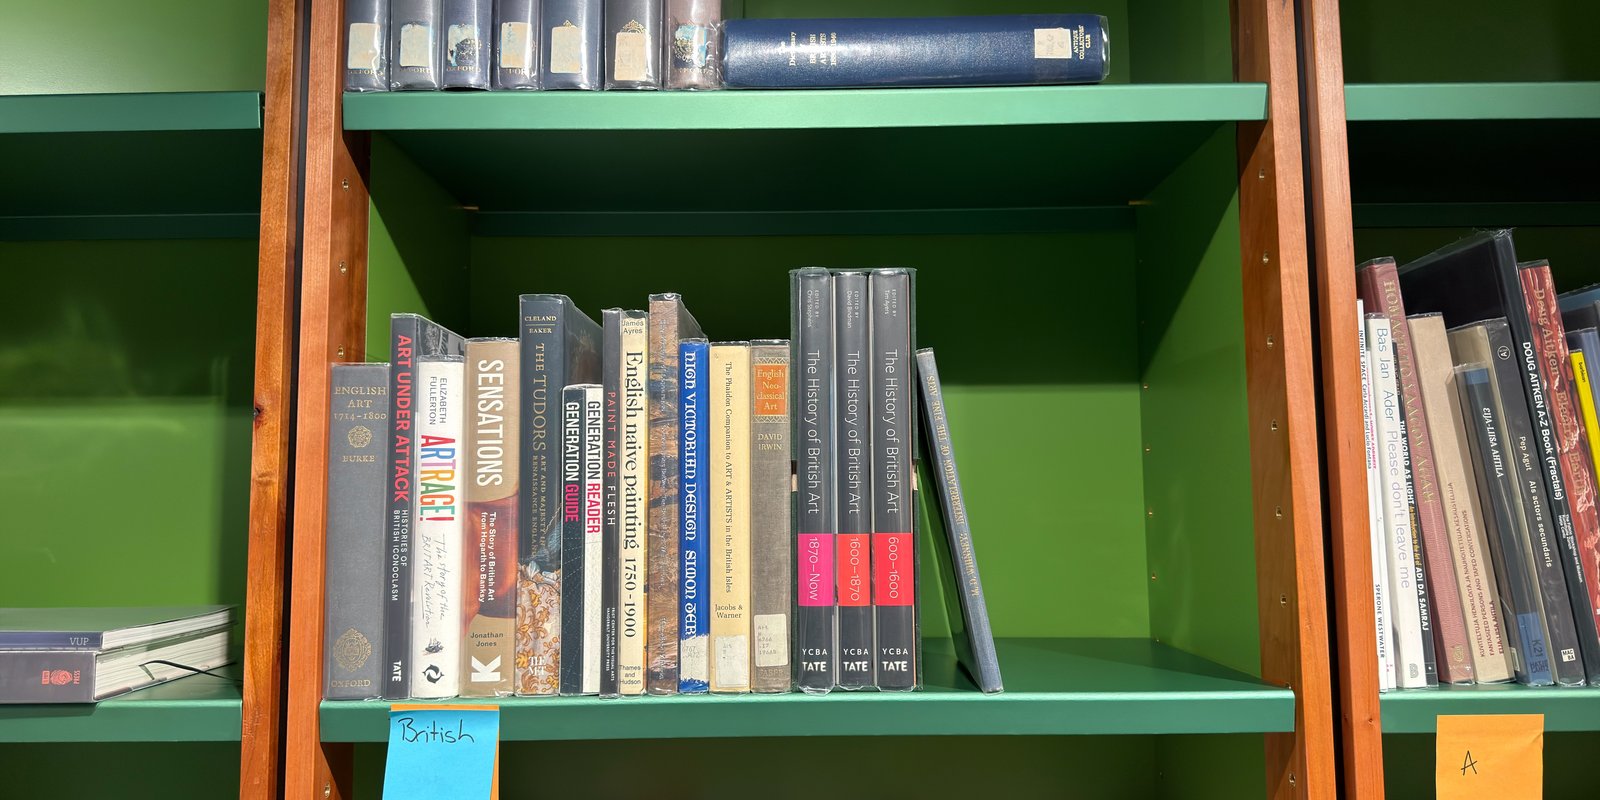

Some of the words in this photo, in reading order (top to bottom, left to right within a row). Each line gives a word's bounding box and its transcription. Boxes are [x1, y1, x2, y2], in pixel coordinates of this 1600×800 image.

[1377, 328, 1388, 352] Bas
[1533, 288, 1549, 326] Doug
[1542, 328, 1559, 375] Aitken
[397, 335, 412, 367] ART
[535, 343, 545, 371] THE
[807, 350, 820, 373] The
[847, 350, 860, 374] The
[885, 349, 898, 373] The
[1523, 342, 1536, 371] DOUG
[725, 361, 733, 376] The
[756, 369, 784, 378] English
[1380, 358, 1390, 379] Jan
[334, 386, 387, 397] ENGLISH
[624, 351, 643, 418] English
[723, 377, 733, 407] Phaidon
[756, 391, 785, 400] classical
[761, 381, 783, 390] Neo-
[926, 375, 939, 396] ARTS
[1529, 372, 1545, 409] AITKEN
[346, 398, 373, 409] ART
[396, 372, 411, 430] UNDER
[429, 376, 437, 425] FULLERTON
[438, 377, 447, 423] ELIZABETH
[532, 373, 548, 450] TUDORS
[606, 391, 617, 434] PAINT
[763, 402, 778, 411] Art
[804, 378, 820, 424] History
[844, 378, 860, 424] History
[882, 377, 899, 423] History
[931, 400, 943, 421] FINE
[1384, 389, 1395, 421] Ader
[333, 411, 387, 421] 1714-1800
[476, 359, 504, 487] SENSATIONS
[1537, 410, 1548, 428] A-Z
[565, 402, 580, 481] GENERATION
[586, 400, 601, 480] GENERATION
[685, 391, 697, 479] VICTORIAN
[723, 408, 733, 451] Companion
[757, 433, 783, 441] DAVID
[807, 428, 821, 444] of
[848, 428, 861, 444] of
[886, 428, 899, 443] of
[936, 424, 949, 443] THE
[1541, 428, 1554, 455] Book
[626, 423, 641, 471] naive
[758, 443, 783, 451] IRWIN
[939, 444, 950, 456] OF
[1387, 430, 1398, 476] Please
[1401, 437, 1409, 466] WORLD
[1483, 407, 1497, 447] EIJA-LIISA
[1491, 448, 1504, 478] AHTILA
[1519, 436, 1527, 451] Pep
[342, 454, 376, 463] BURKE
[394, 435, 410, 502] ATTACK
[606, 440, 616, 478] MADE
[724, 452, 731, 460] to
[807, 447, 821, 487] British
[848, 447, 861, 487] British
[886, 447, 899, 487] British
[1522, 453, 1532, 471] Agut
[420, 434, 456, 521] ARTRAGE!
[724, 461, 732, 479] ART
[1404, 469, 1412, 480] AS
[1546, 456, 1564, 501] (Fractals)
[565, 483, 579, 522] GUIDE
[808, 492, 820, 514] Art
[848, 492, 861, 514] Art
[887, 491, 899, 513] Art
[943, 459, 965, 525] INTERRELATION
[1392, 481, 1406, 518] don't
[1406, 481, 1415, 505] LIGHT
[538, 494, 546, 533] MAJESTY
[586, 482, 601, 533] READER
[606, 485, 616, 526] FLESH
[623, 474, 643, 550] painting
[685, 482, 697, 541] DESIGN
[724, 488, 732, 523] ARTISTS
[393, 509, 401, 543] BRITISH
[400, 509, 408, 552] HISTORIES
[480, 511, 488, 530] from
[488, 511, 496, 526] The
[723, 525, 732, 533] in
[487, 528, 496, 550] Story
[538, 535, 546, 547] IN
[723, 534, 731, 547] the
[1395, 523, 1407, 561] leave
[1462, 510, 1475, 558] CONVERSATIONS
[1532, 496, 1542, 521] actors
[1538, 524, 1553, 568] secundaris
[435, 534, 449, 561] The
[478, 531, 488, 563] Hogarth
[487, 551, 496, 559] of
[391, 544, 400, 601] ICONOCLASM
[400, 555, 407, 567] OF
[479, 564, 487, 572] to
[487, 560, 496, 586] British
[723, 548, 732, 574] British
[1471, 558, 1480, 578] TAPED
[434, 561, 450, 588] story
[685, 549, 697, 600] SIMON
[723, 576, 732, 593] Isles
[1400, 566, 1409, 589] me
[1415, 567, 1423, 583] ADI
[436, 588, 450, 600] of
[477, 573, 487, 603] Banksy
[487, 588, 495, 601] Art
[1417, 584, 1424, 595] DA
[438, 600, 449, 621] the
[715, 603, 737, 612] Jacobs
[1419, 598, 1429, 631] SAMRAJ
[1478, 592, 1488, 619] PERSONS
[69, 637, 90, 646] VUP
[475, 640, 497, 648] Jones
[1481, 619, 1494, 656] FANTASIZED
[1532, 639, 1543, 657] K21
[881, 647, 908, 655] YCBA
[391, 660, 402, 682] TATE
[801, 661, 827, 671] TATE
[843, 661, 868, 671] TATE
[882, 661, 908, 672] TATE
[331, 677, 371, 688] OXFORD
[397, 717, 475, 743] British
[1460, 750, 1478, 776] A
